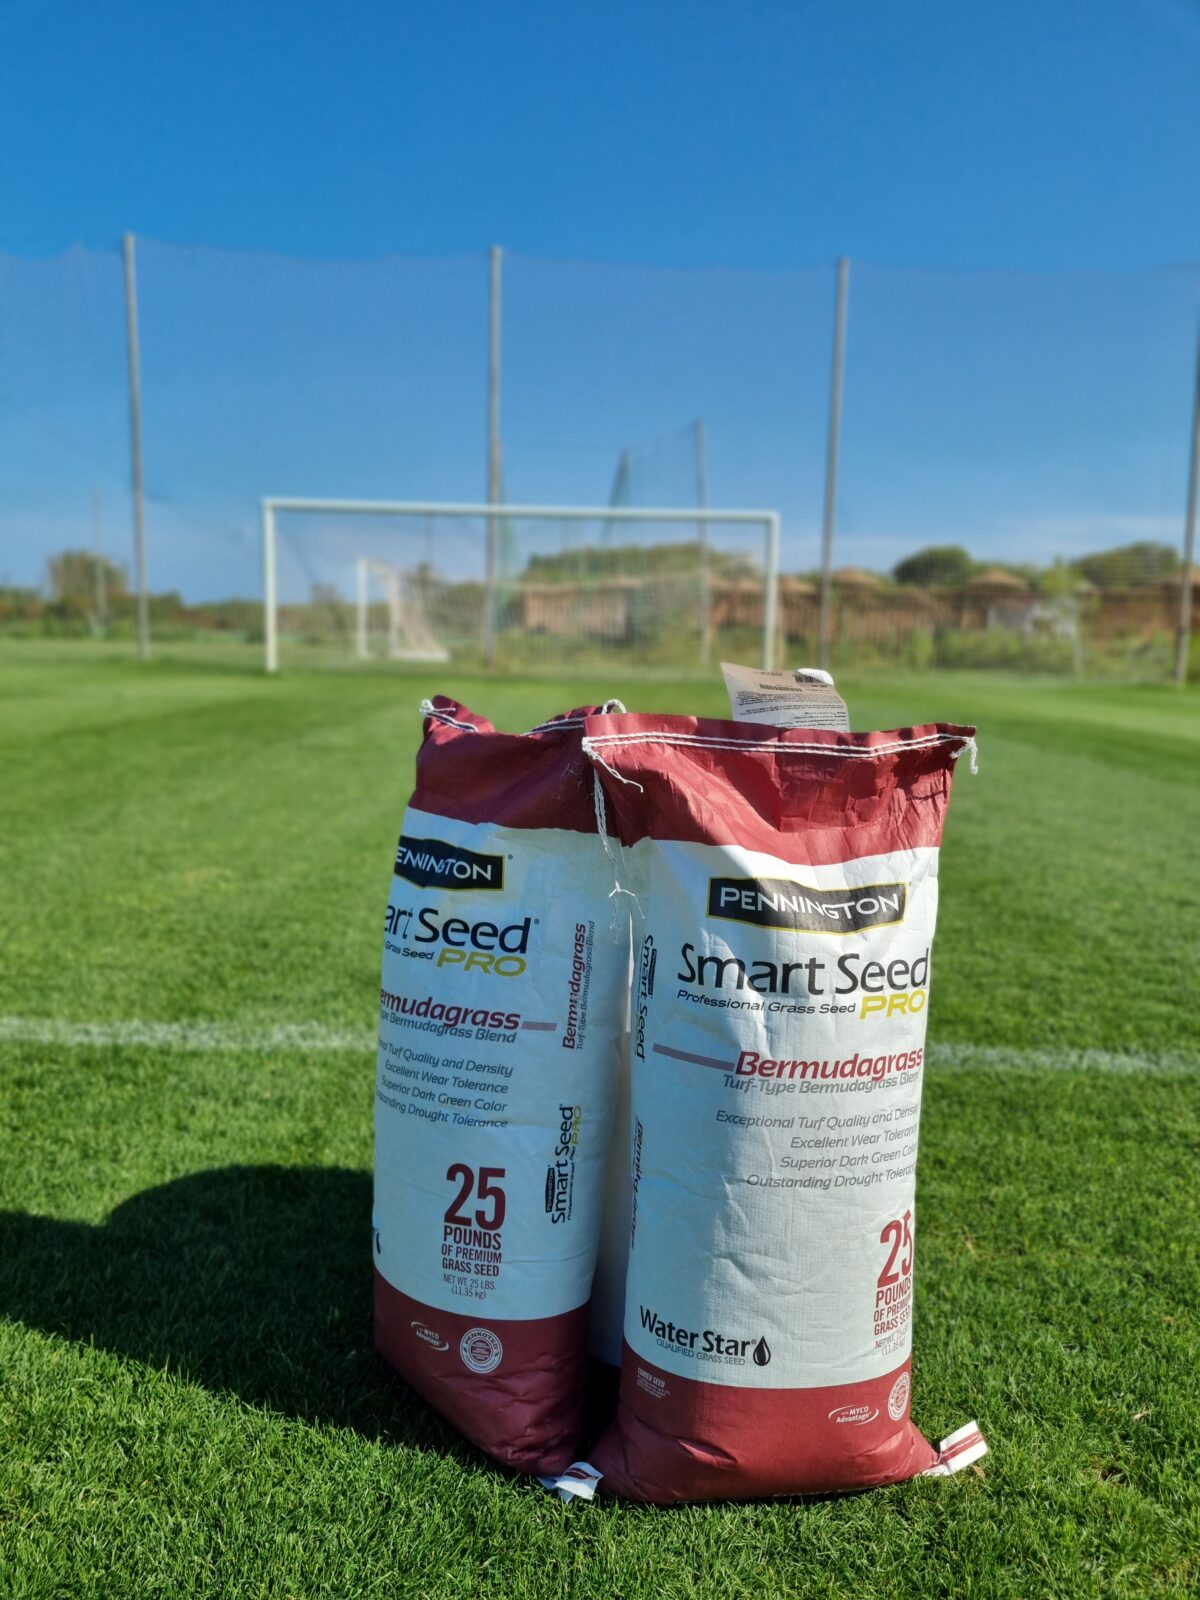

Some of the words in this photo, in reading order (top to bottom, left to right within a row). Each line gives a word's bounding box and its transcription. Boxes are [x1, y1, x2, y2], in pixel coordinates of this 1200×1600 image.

[395, 846, 492, 881] ENNINGTON
[720, 887, 900, 920] PENNINGTON
[384, 905, 413, 939] art
[415, 907, 531, 954] Seed
[402, 947, 434, 960] Seed
[437, 948, 527, 977] PRO
[678, 943, 825, 995] Smart
[836, 948, 929, 994] Seed
[677, 989, 764, 1012] Professional
[768, 1001, 816, 1014] Grass
[819, 1003, 855, 1014] Seed
[859, 990, 926, 1020] PRO
[390, 1012, 473, 1038] Bermudagrass
[475, 1028, 517, 1043] Blend
[637, 1003, 649, 1060] Seed
[388, 1043, 404, 1058] Turf
[403, 1049, 440, 1067] Quality
[441, 1058, 464, 1070] and
[465, 1060, 514, 1078] Density
[735, 1048, 923, 1082] Bermudagrass
[385, 1060, 419, 1080] Excellent
[421, 1071, 449, 1086] Wear
[452, 1076, 509, 1094] Tolerance
[723, 1075, 795, 1096] Turf-Type
[799, 1075, 897, 1095] Bermudagrass
[382, 1074, 411, 1096] Superior
[412, 1087, 436, 1103] Dark
[438, 1093, 472, 1109] Green
[474, 1098, 508, 1112] Color
[408, 1103, 449, 1123] Drought
[452, 1113, 508, 1128] Tolerance
[572, 1106, 582, 1145] PRO
[716, 1110, 794, 1129] Exceptional
[798, 1116, 825, 1130] Turf
[826, 1115, 870, 1130] Quality
[872, 1109, 893, 1124] and
[555, 1106, 574, 1156] Seed
[791, 1135, 849, 1149] Excellent
[851, 1133, 881, 1146] Wear
[780, 1155, 837, 1170] Superior
[839, 1154, 868, 1167] Dark
[871, 1149, 900, 1164] Green
[552, 1160, 568, 1223] Smart
[747, 1174, 831, 1190] Outstanding
[834, 1170, 883, 1187] Drought
[444, 1163, 506, 1231] 25
[443, 1225, 502, 1251] POUNDS
[877, 1209, 913, 1288] 25
[441, 1243, 453, 1257] OF
[456, 1246, 502, 1264] PREMIUM
[442, 1257, 472, 1274] GRASS
[474, 1263, 499, 1277] SEED
[443, 1273, 456, 1285] NET
[470, 1279, 479, 1288] 25
[481, 1281, 497, 1291] LBS.
[874, 1309, 885, 1322] OF
[875, 1316, 898, 1335] GRASS
[640, 1305, 699, 1349] Water
[702, 1331, 750, 1356] Star
[656, 1338, 694, 1358] QUALIFIED
[696, 1352, 721, 1364] GRASS
[724, 1356, 746, 1366] SEED
[836, 1411, 870, 1424] Advantage
[850, 1406, 869, 1416] MYCO
